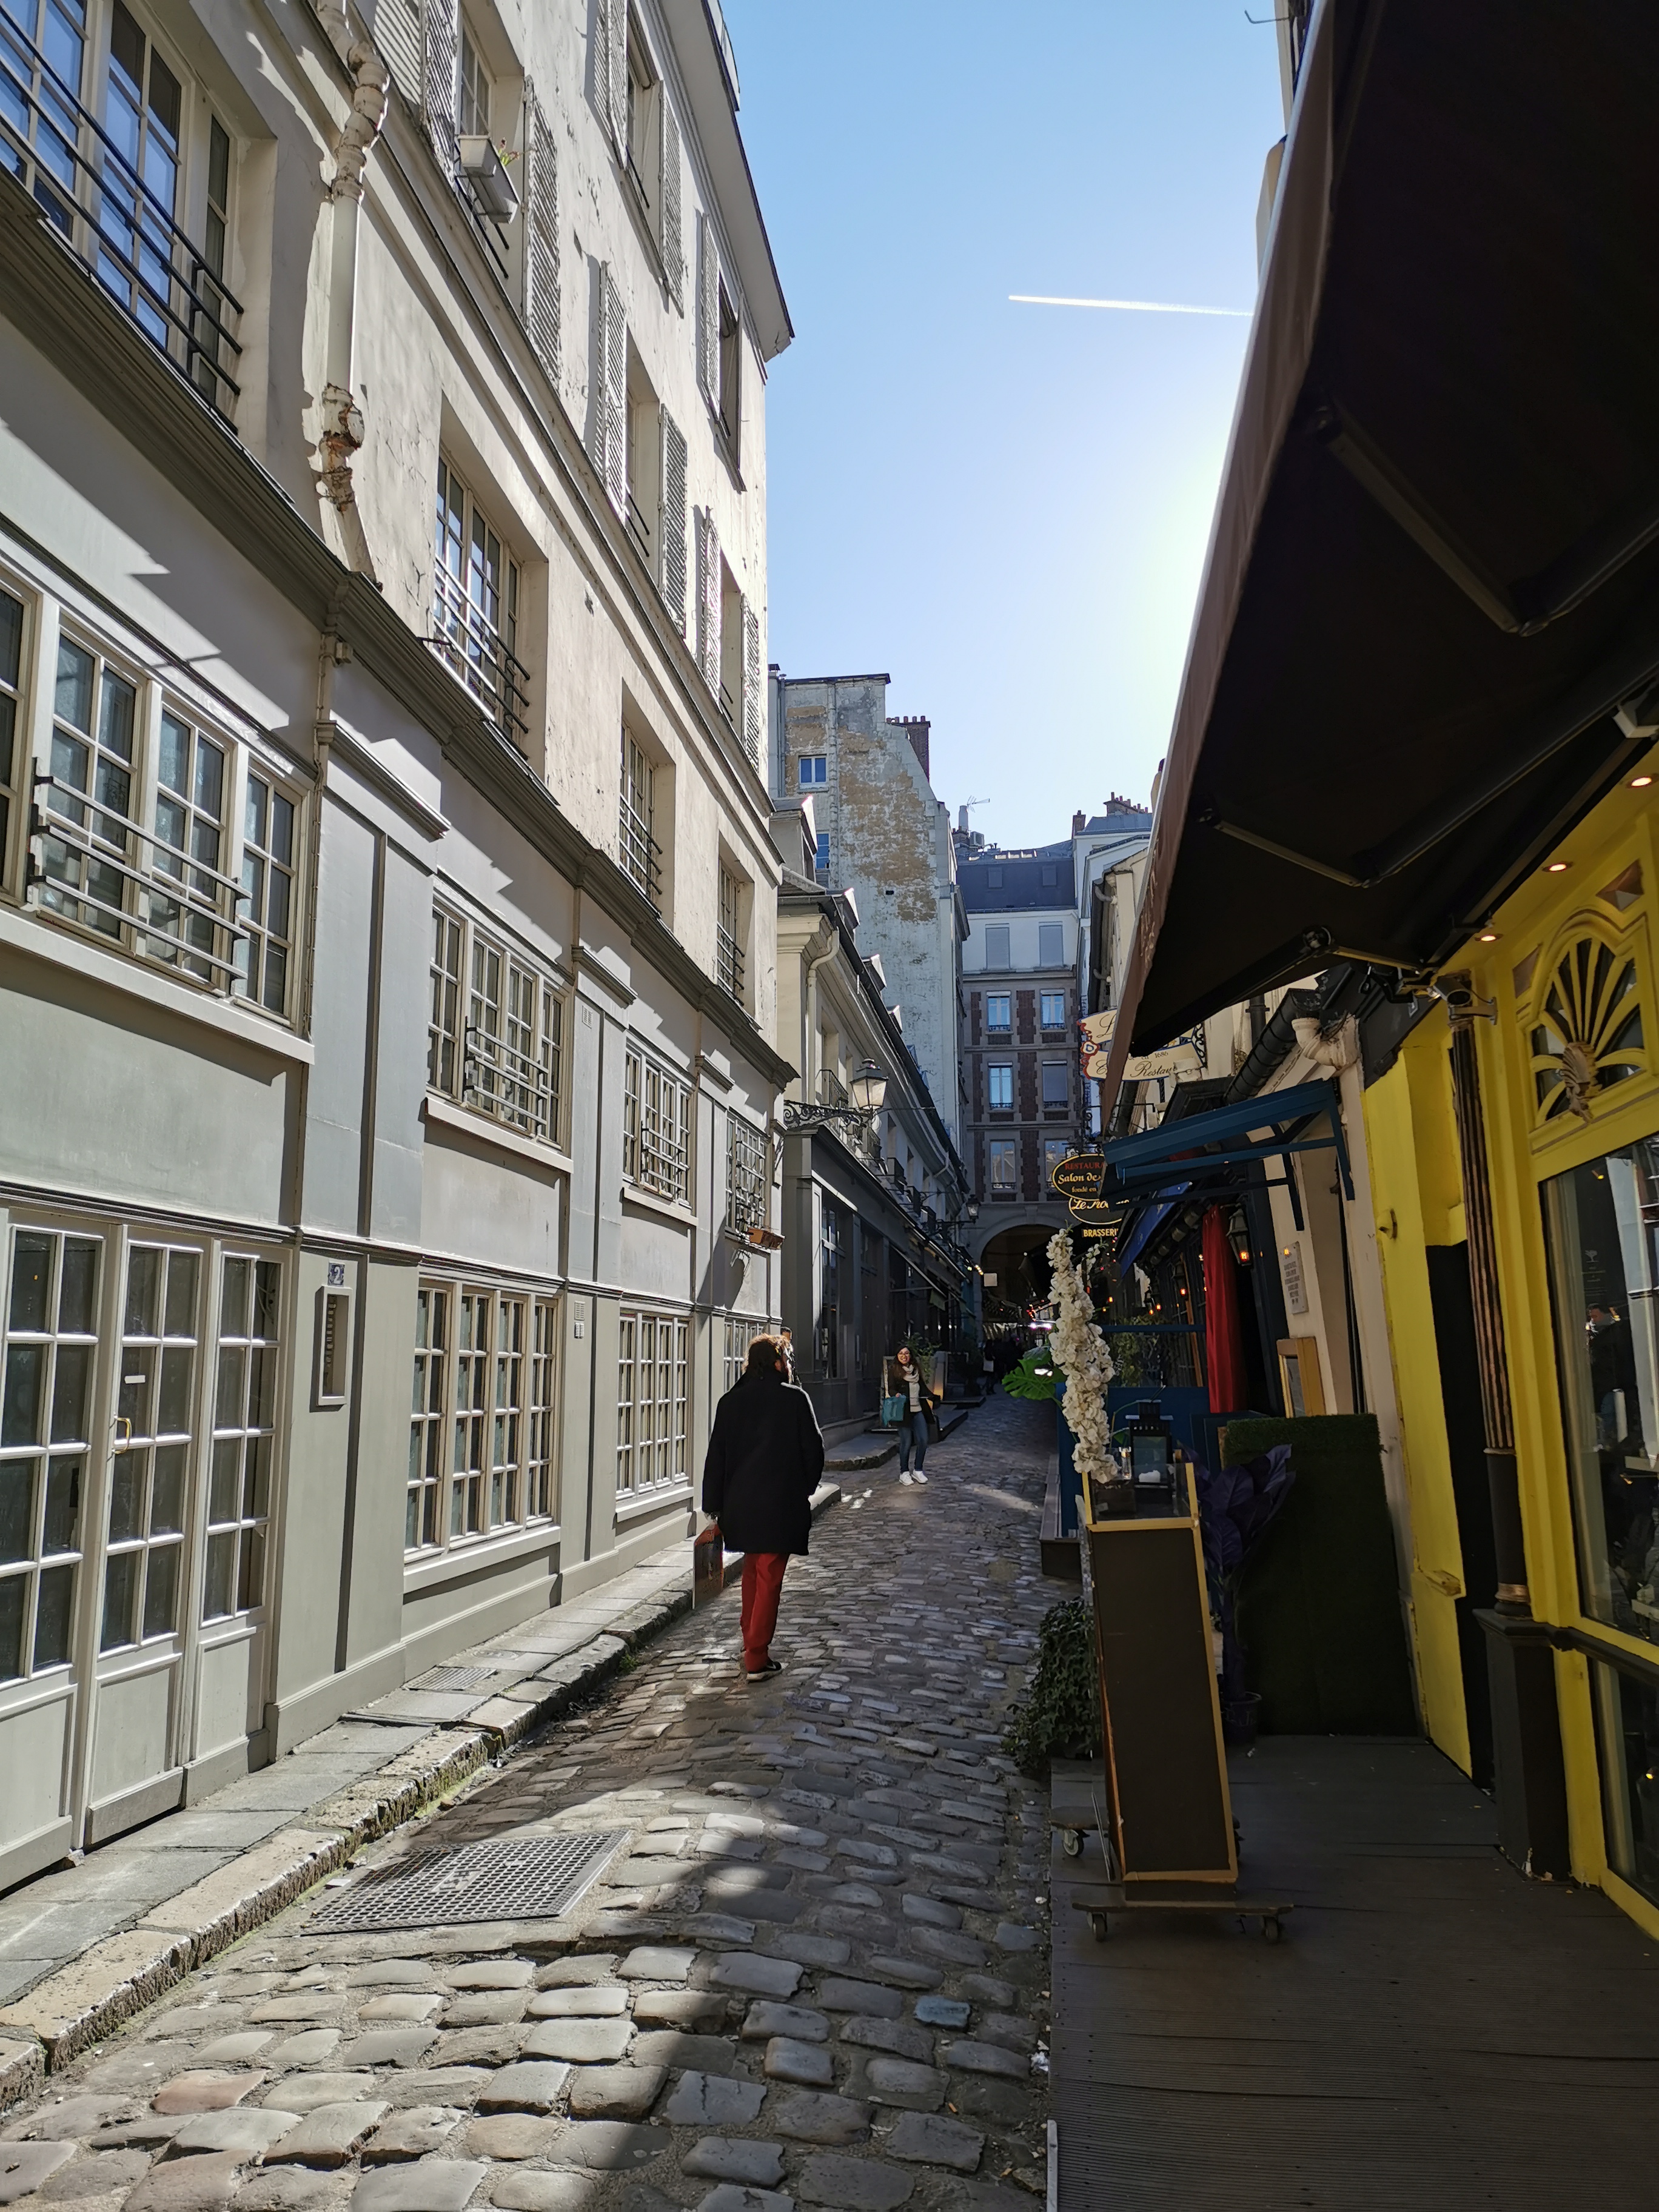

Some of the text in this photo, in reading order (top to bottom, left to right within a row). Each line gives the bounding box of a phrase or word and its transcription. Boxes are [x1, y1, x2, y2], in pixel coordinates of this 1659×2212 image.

[1057, 1172, 1085, 1184] Salon
[1083, 1228, 1119, 1237] BRASSERI
[333, 1266, 341, 1284] 2
